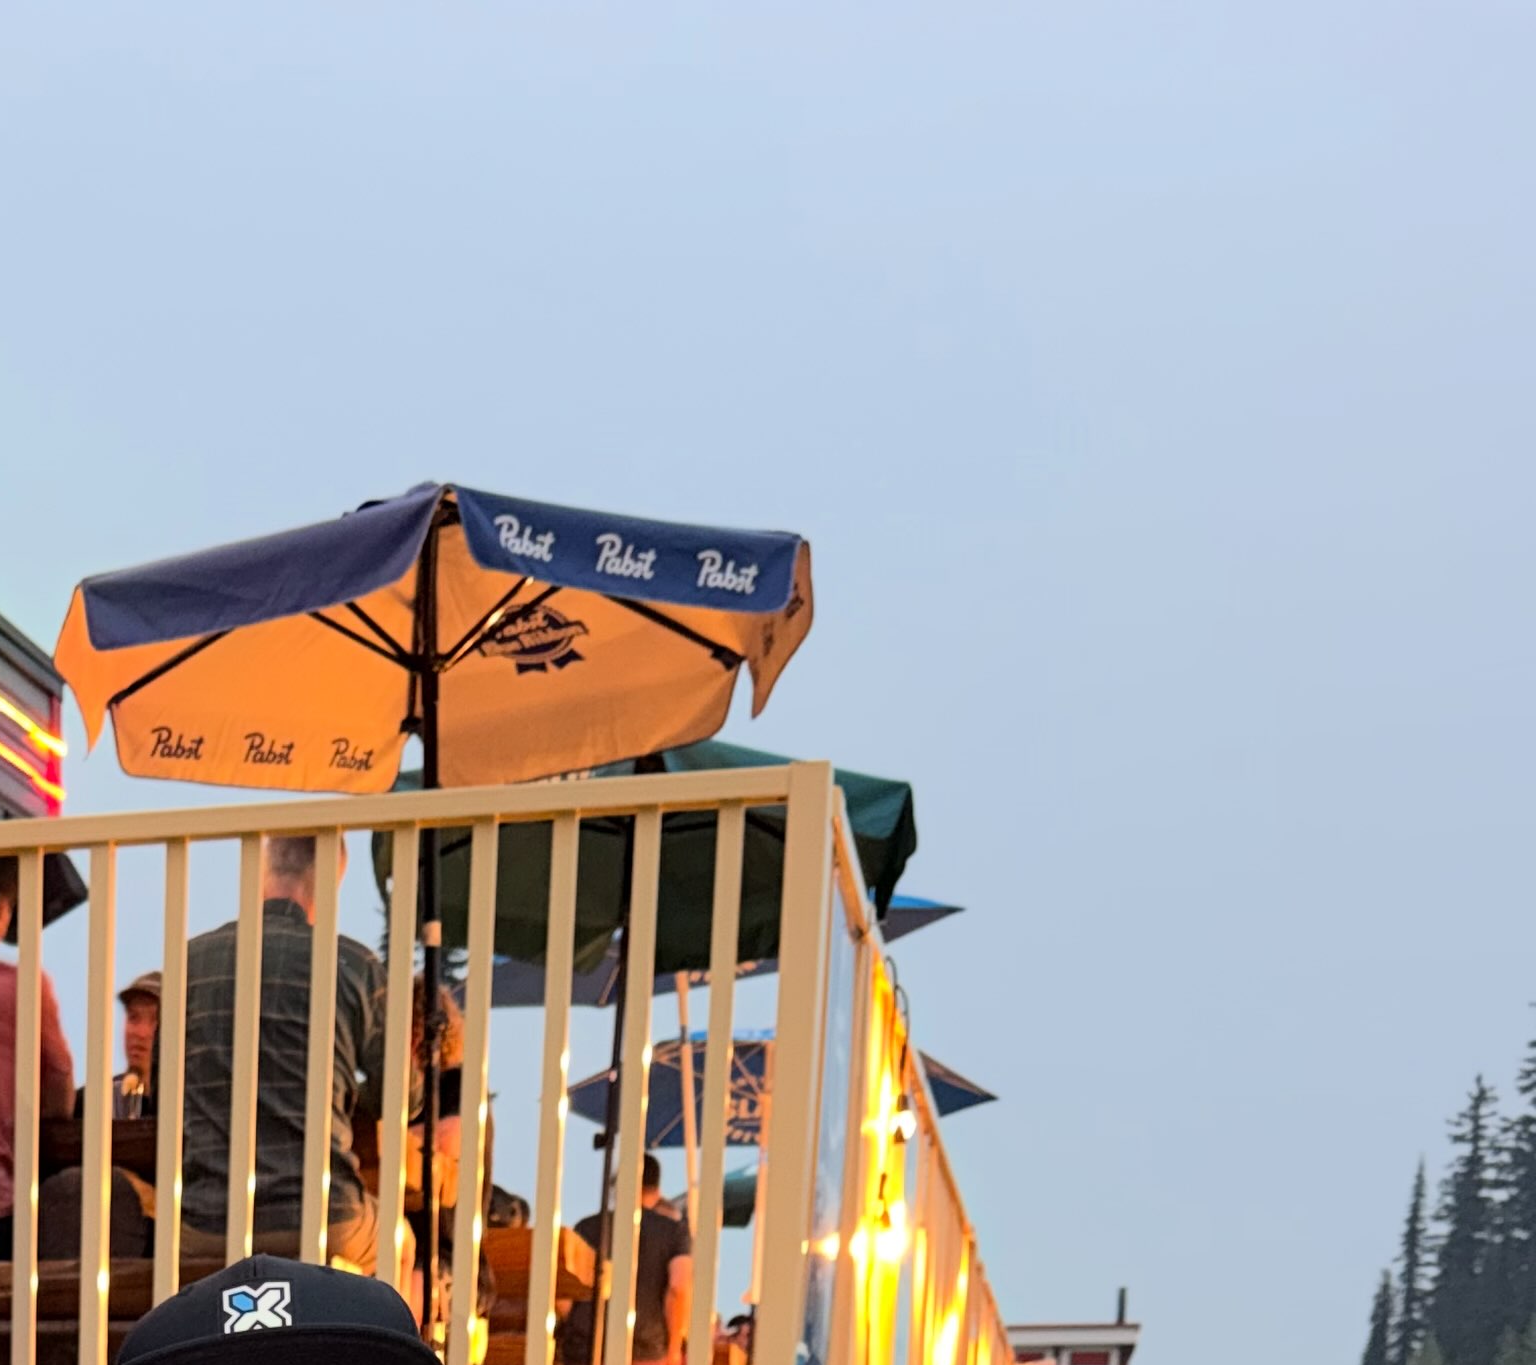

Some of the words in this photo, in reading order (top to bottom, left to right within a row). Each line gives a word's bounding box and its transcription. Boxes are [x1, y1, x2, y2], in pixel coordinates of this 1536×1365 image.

[494, 515, 555, 562] Pabst
[595, 533, 657, 580] Pabst
[697, 549, 758, 594] Pabst
[150, 726, 204, 760] Pabst
[244, 732, 295, 765] Pabst
[329, 738, 374, 771] Pabst
